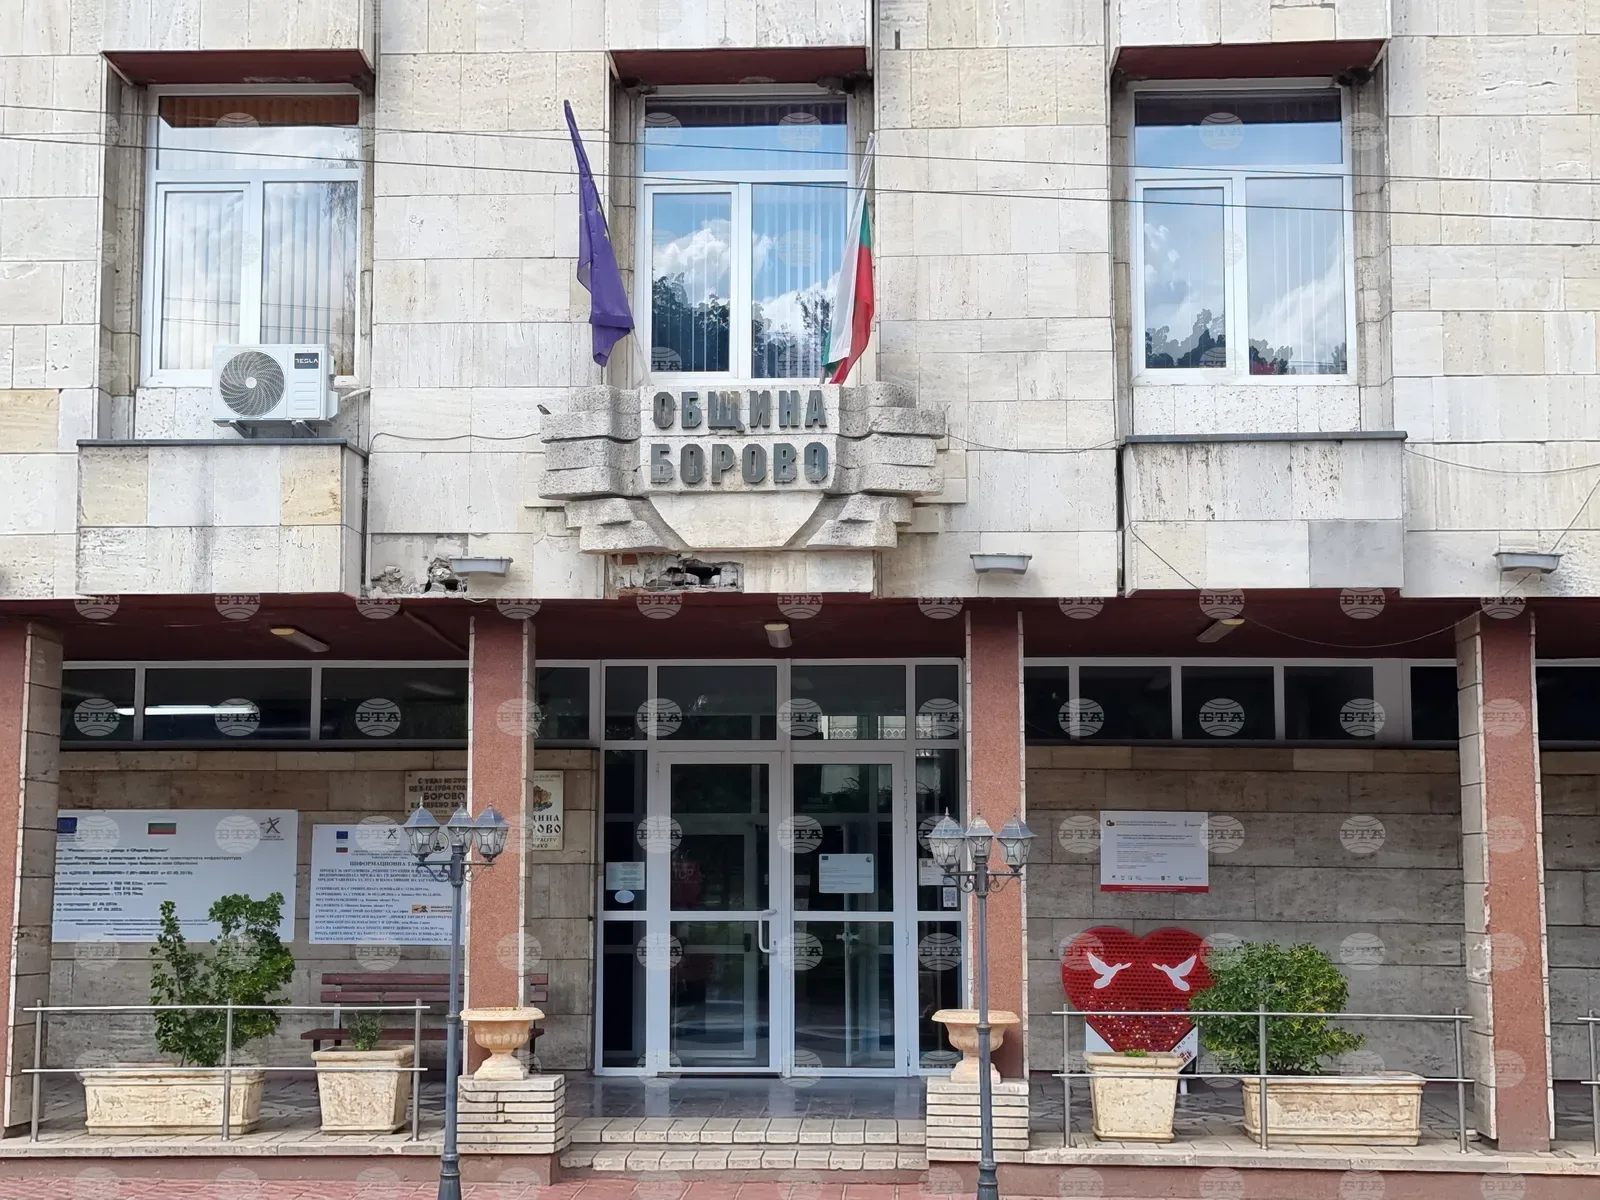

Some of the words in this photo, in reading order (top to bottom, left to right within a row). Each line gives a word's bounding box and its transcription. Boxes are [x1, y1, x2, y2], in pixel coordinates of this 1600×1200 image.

[652, 389, 828, 433] ОБЩИНА
[650, 441, 829, 484] БОРОВО
[423, 792, 465, 800] БОРОВО
[533, 824, 561, 834] ОВО
